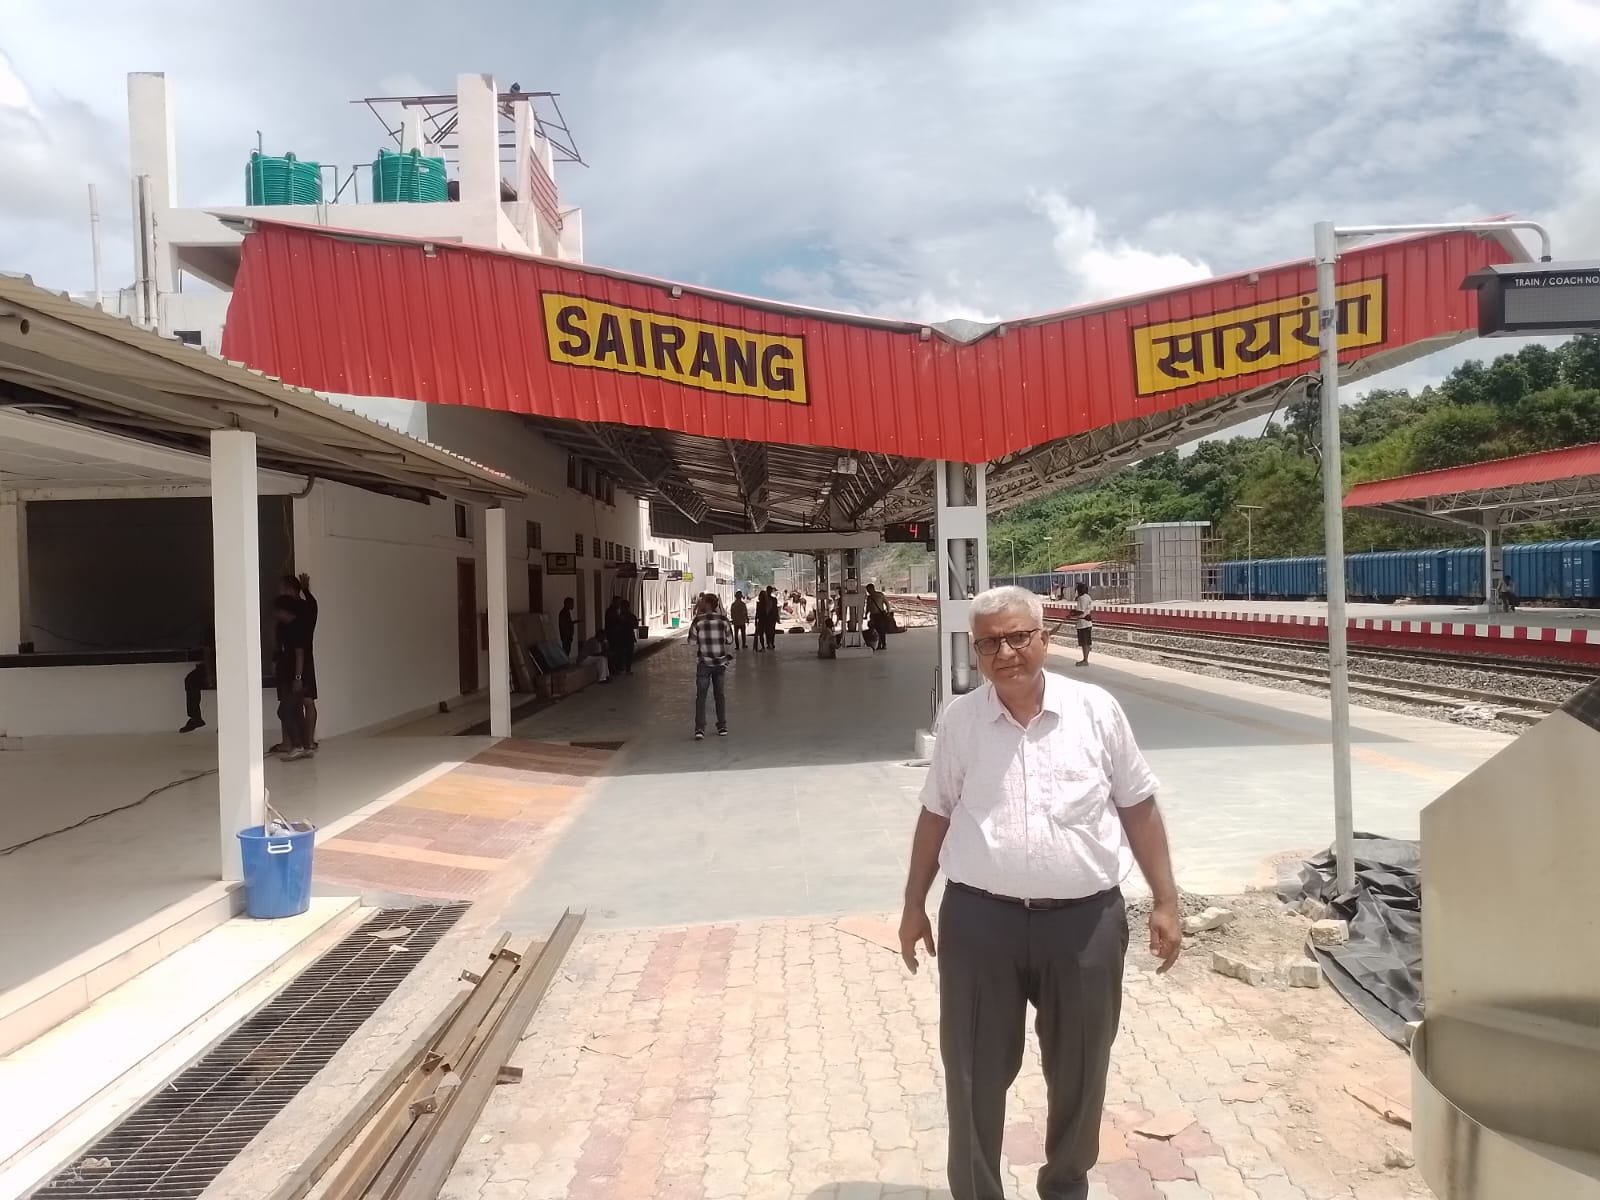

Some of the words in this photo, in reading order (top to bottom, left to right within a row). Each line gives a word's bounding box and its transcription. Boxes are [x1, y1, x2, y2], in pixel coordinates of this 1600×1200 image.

[1515, 278, 1540, 287] TRAIN
[1548, 276, 1583, 286] COACH
[556, 305, 795, 391] SAIRANG
